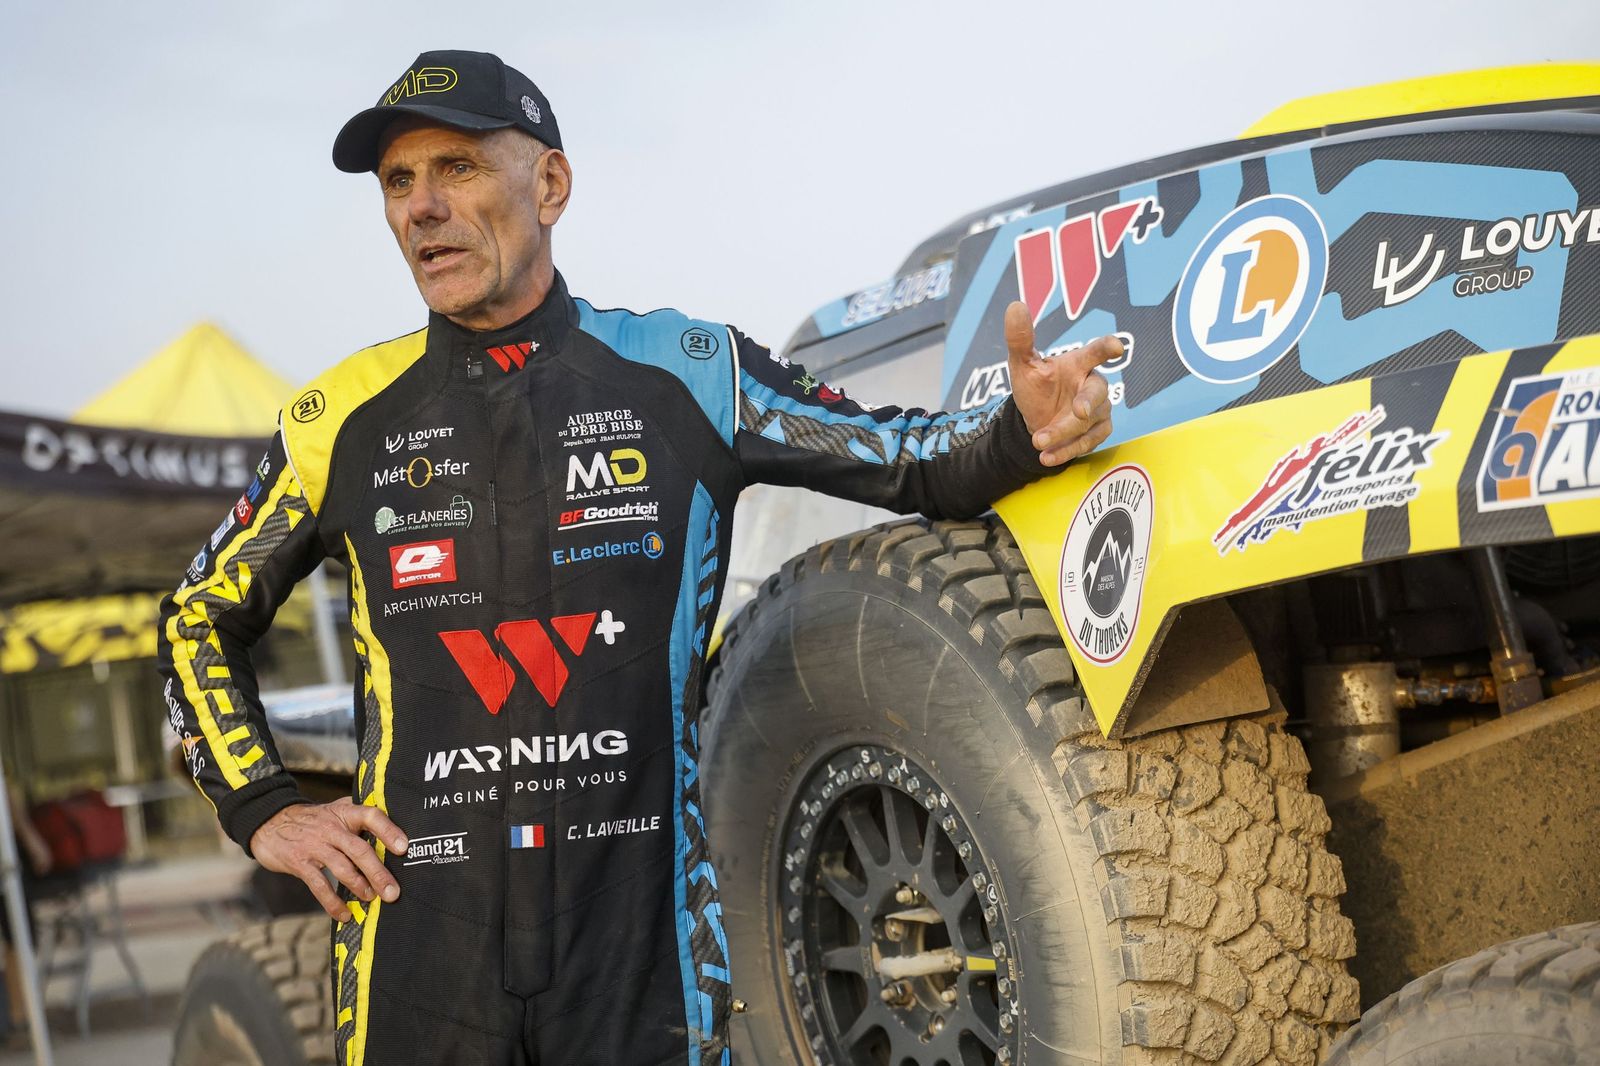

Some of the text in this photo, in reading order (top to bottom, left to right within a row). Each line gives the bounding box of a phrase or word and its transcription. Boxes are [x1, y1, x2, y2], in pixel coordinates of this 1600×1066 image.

[1456, 269, 1532, 295] GROUP
[690, 335, 710, 351] 21
[299, 397, 319, 416] 21
[1558, 391, 1600, 416] RO
[567, 409, 632, 427] AUBERGE
[570, 423, 608, 437] PÈRE
[610, 420, 643, 432] BISE
[408, 442, 429, 451] GROUP
[409, 428, 454, 441] LOUYET
[566, 448, 647, 492] MD
[1294, 434, 1440, 503] félix
[566, 486, 650, 501] RALLYE SPORT
[1321, 475, 1404, 500] transports
[560, 502, 658, 525] BFGoodrich
[1084, 479, 1145, 525] LES CHALETS
[1263, 486, 1417, 528] manutention levage
[407, 509, 468, 525] FLÂNERIES
[552, 541, 640, 566] E.Leclerc
[384, 592, 482, 617] ARCHIWATCH
[1079, 612, 1129, 655] DU THORENS
[424, 771, 628, 809] IMAGINÉ POUR VOUS
[567, 816, 661, 840] C. LAVIEILLE
[407, 837, 464, 859] stand 21
